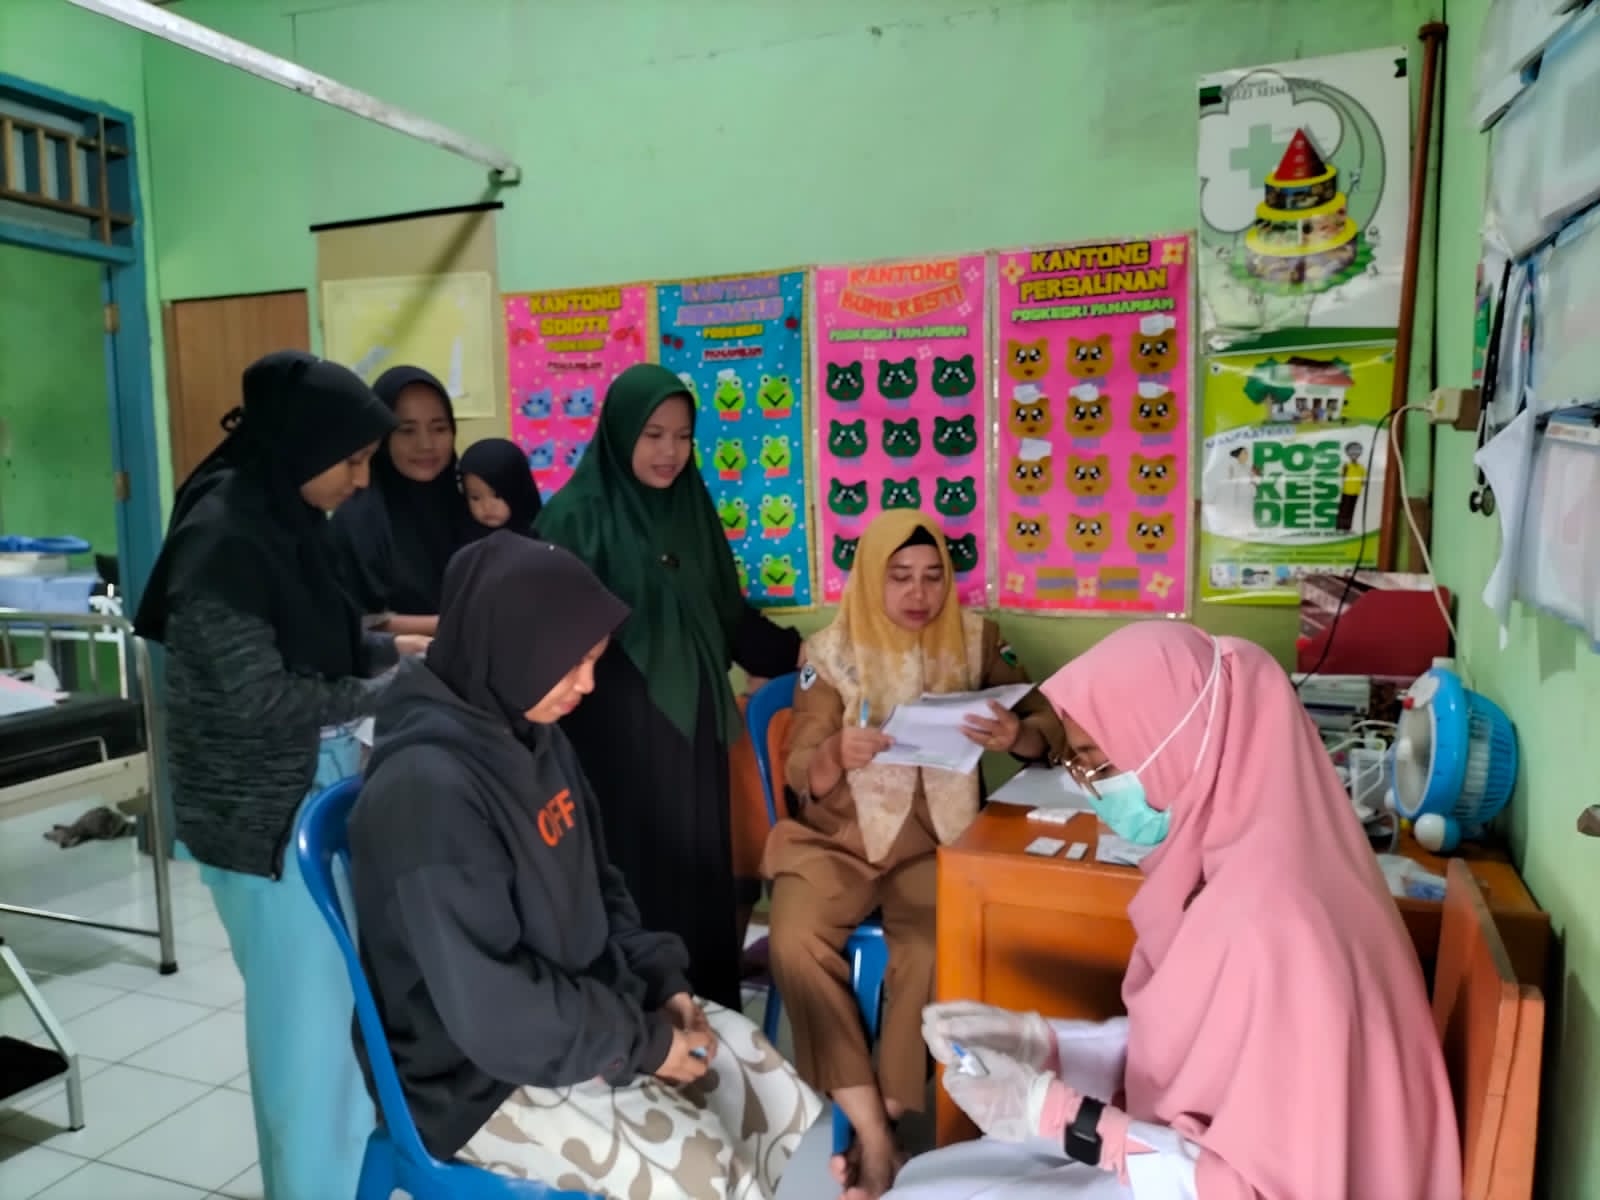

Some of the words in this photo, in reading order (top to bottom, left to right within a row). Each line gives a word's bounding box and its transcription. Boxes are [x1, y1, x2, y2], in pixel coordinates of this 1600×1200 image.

[1031, 241, 1150, 272] KANTONG
[849, 260, 958, 287] KANTONG
[1020, 267, 1168, 303] PERSALINAN
[530, 288, 621, 315] KANTONG
[1252, 440, 1341, 472] POS
[1255, 472, 1340, 500] KES
[1253, 502, 1338, 529] DES
